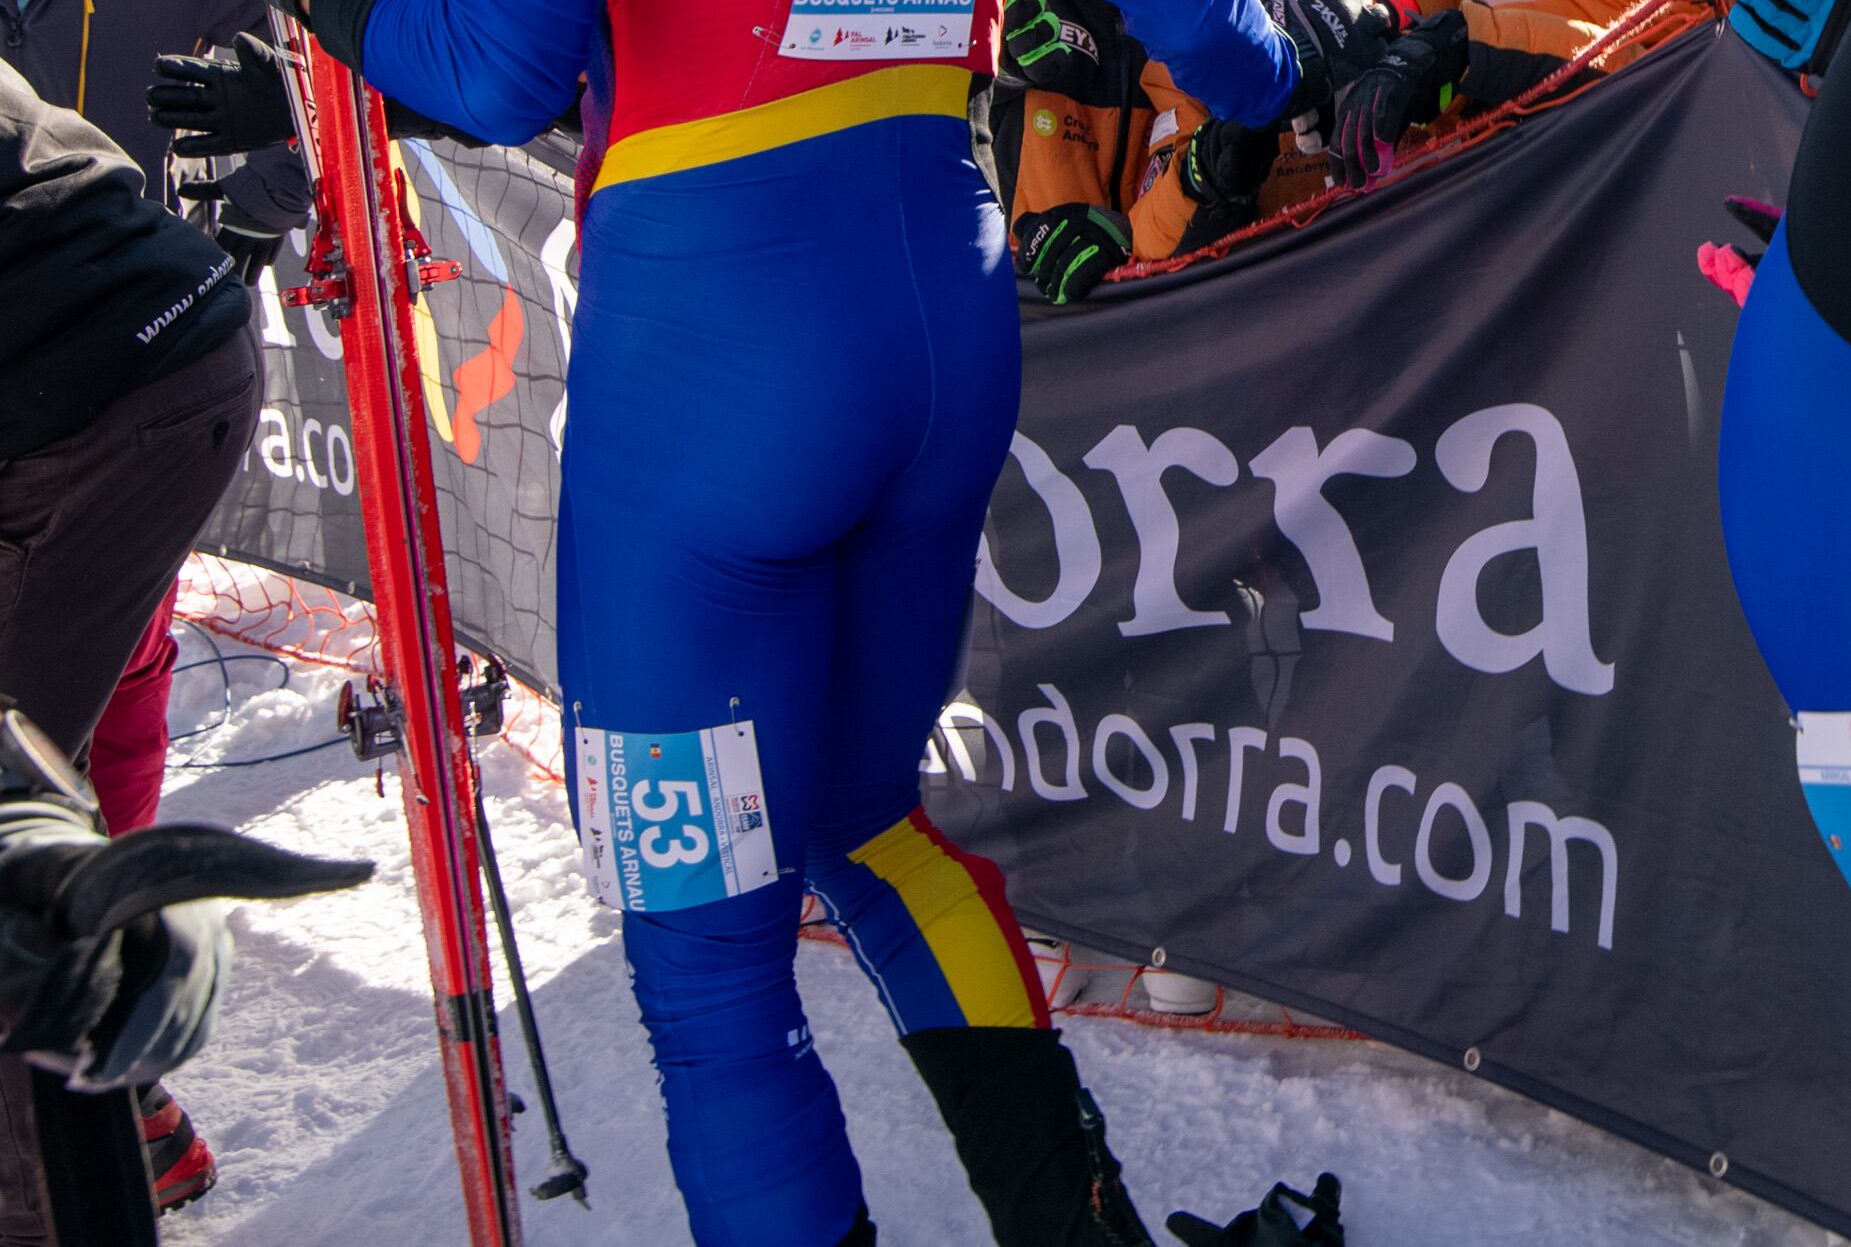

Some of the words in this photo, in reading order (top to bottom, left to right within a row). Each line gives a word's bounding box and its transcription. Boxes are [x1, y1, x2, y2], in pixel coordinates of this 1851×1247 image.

[609, 734, 635, 843] BUSQUETS
[631, 779, 709, 869] 53
[620, 846, 647, 912] ARNAU
